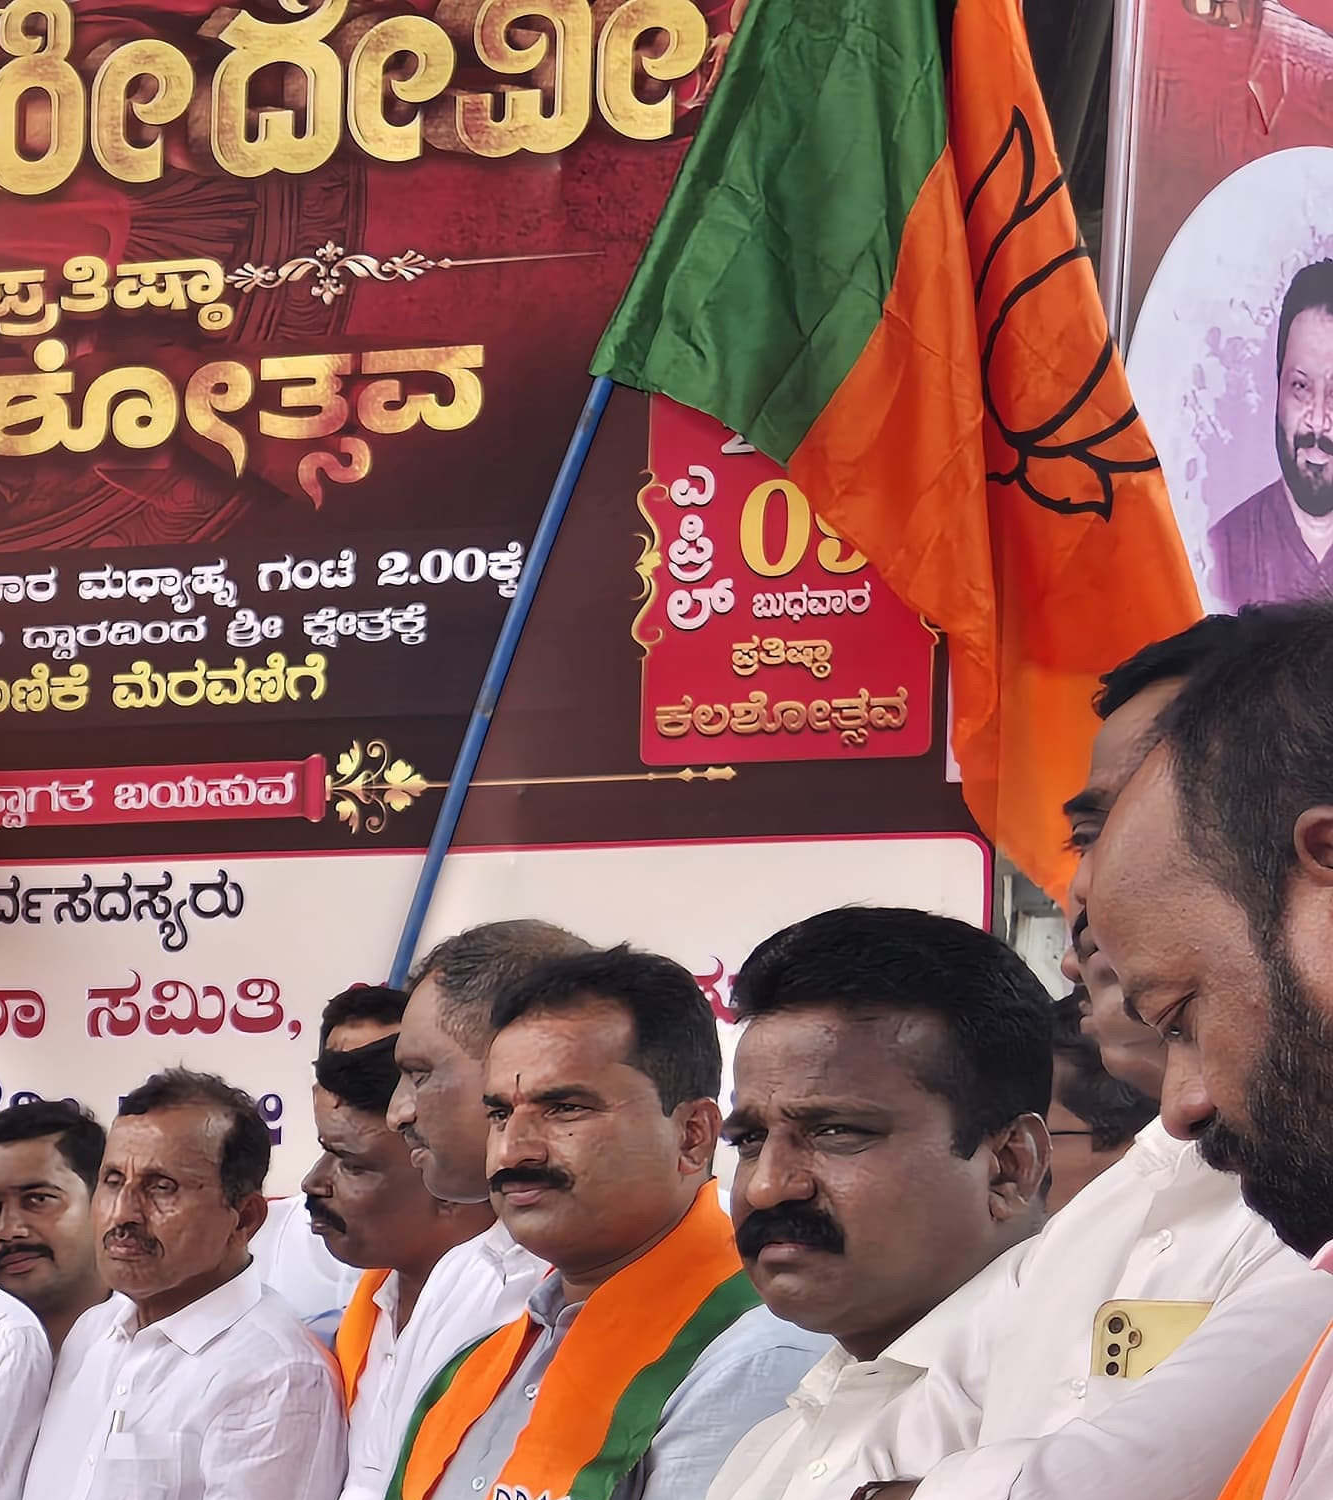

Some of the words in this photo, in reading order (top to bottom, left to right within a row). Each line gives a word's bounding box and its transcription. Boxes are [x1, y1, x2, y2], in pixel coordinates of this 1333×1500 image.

[77, 559, 238, 613] ಮಧ್ಯಾಹ್ನ
[258, 549, 358, 593] ಗಂಟೆ
[751, 581, 872, 623] ಬುಧವಾರ
[22, 615, 207, 661] ದ್ವಾರದಿಂದ
[226, 612, 283, 649] ಶ್ರೀ
[302, 603, 429, 650] ಕ್ಷೇತ್ರಕ್ಕೆ
[730, 637, 833, 679] ಪ್ರತಿಷ್ಠಾ
[112, 653, 329, 714] ಮೆರವಣಿಗೆ
[654, 686, 909, 748] ಕಲಶೋತ್ಸವ
[113, 772, 299, 813] ಬಯಸುವ
[86, 970, 303, 1042] ಸಮಿತಿ,
